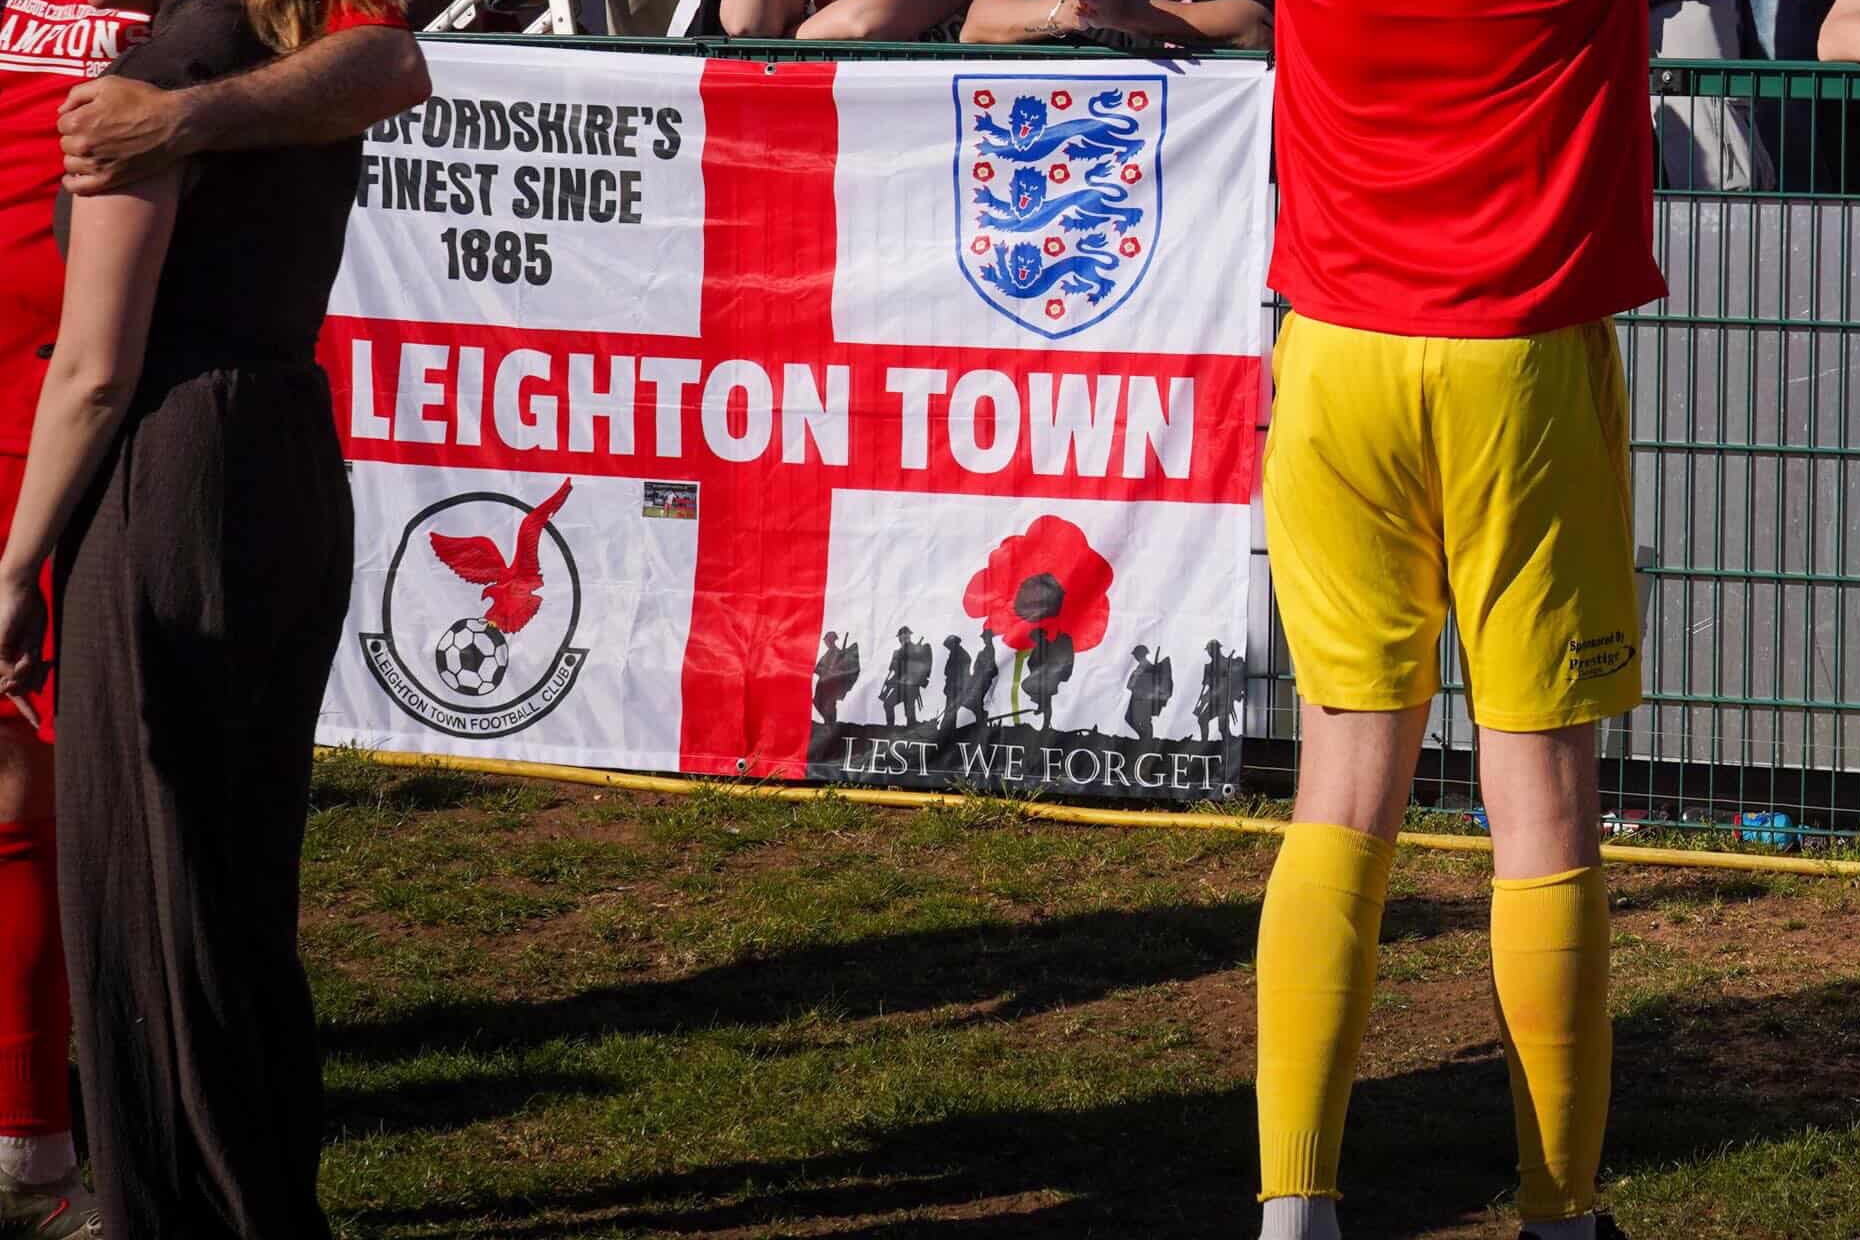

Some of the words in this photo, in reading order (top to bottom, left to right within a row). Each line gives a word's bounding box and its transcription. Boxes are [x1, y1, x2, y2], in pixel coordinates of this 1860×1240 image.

[357, 155, 499, 216] FINEST
[512, 165, 642, 224] SINCE
[440, 227, 553, 286] 1885
[350, 338, 851, 466] LEIGHTON
[885, 367, 1196, 480] TOWN
[375, 651, 430, 714] LEIGHTON
[430, 707, 467, 730] TOWN
[470, 702, 541, 730] FOOTBALL
[541, 666, 571, 703] CLUB
[840, 736, 938, 777] LEST
[957, 742, 1026, 782] WE
